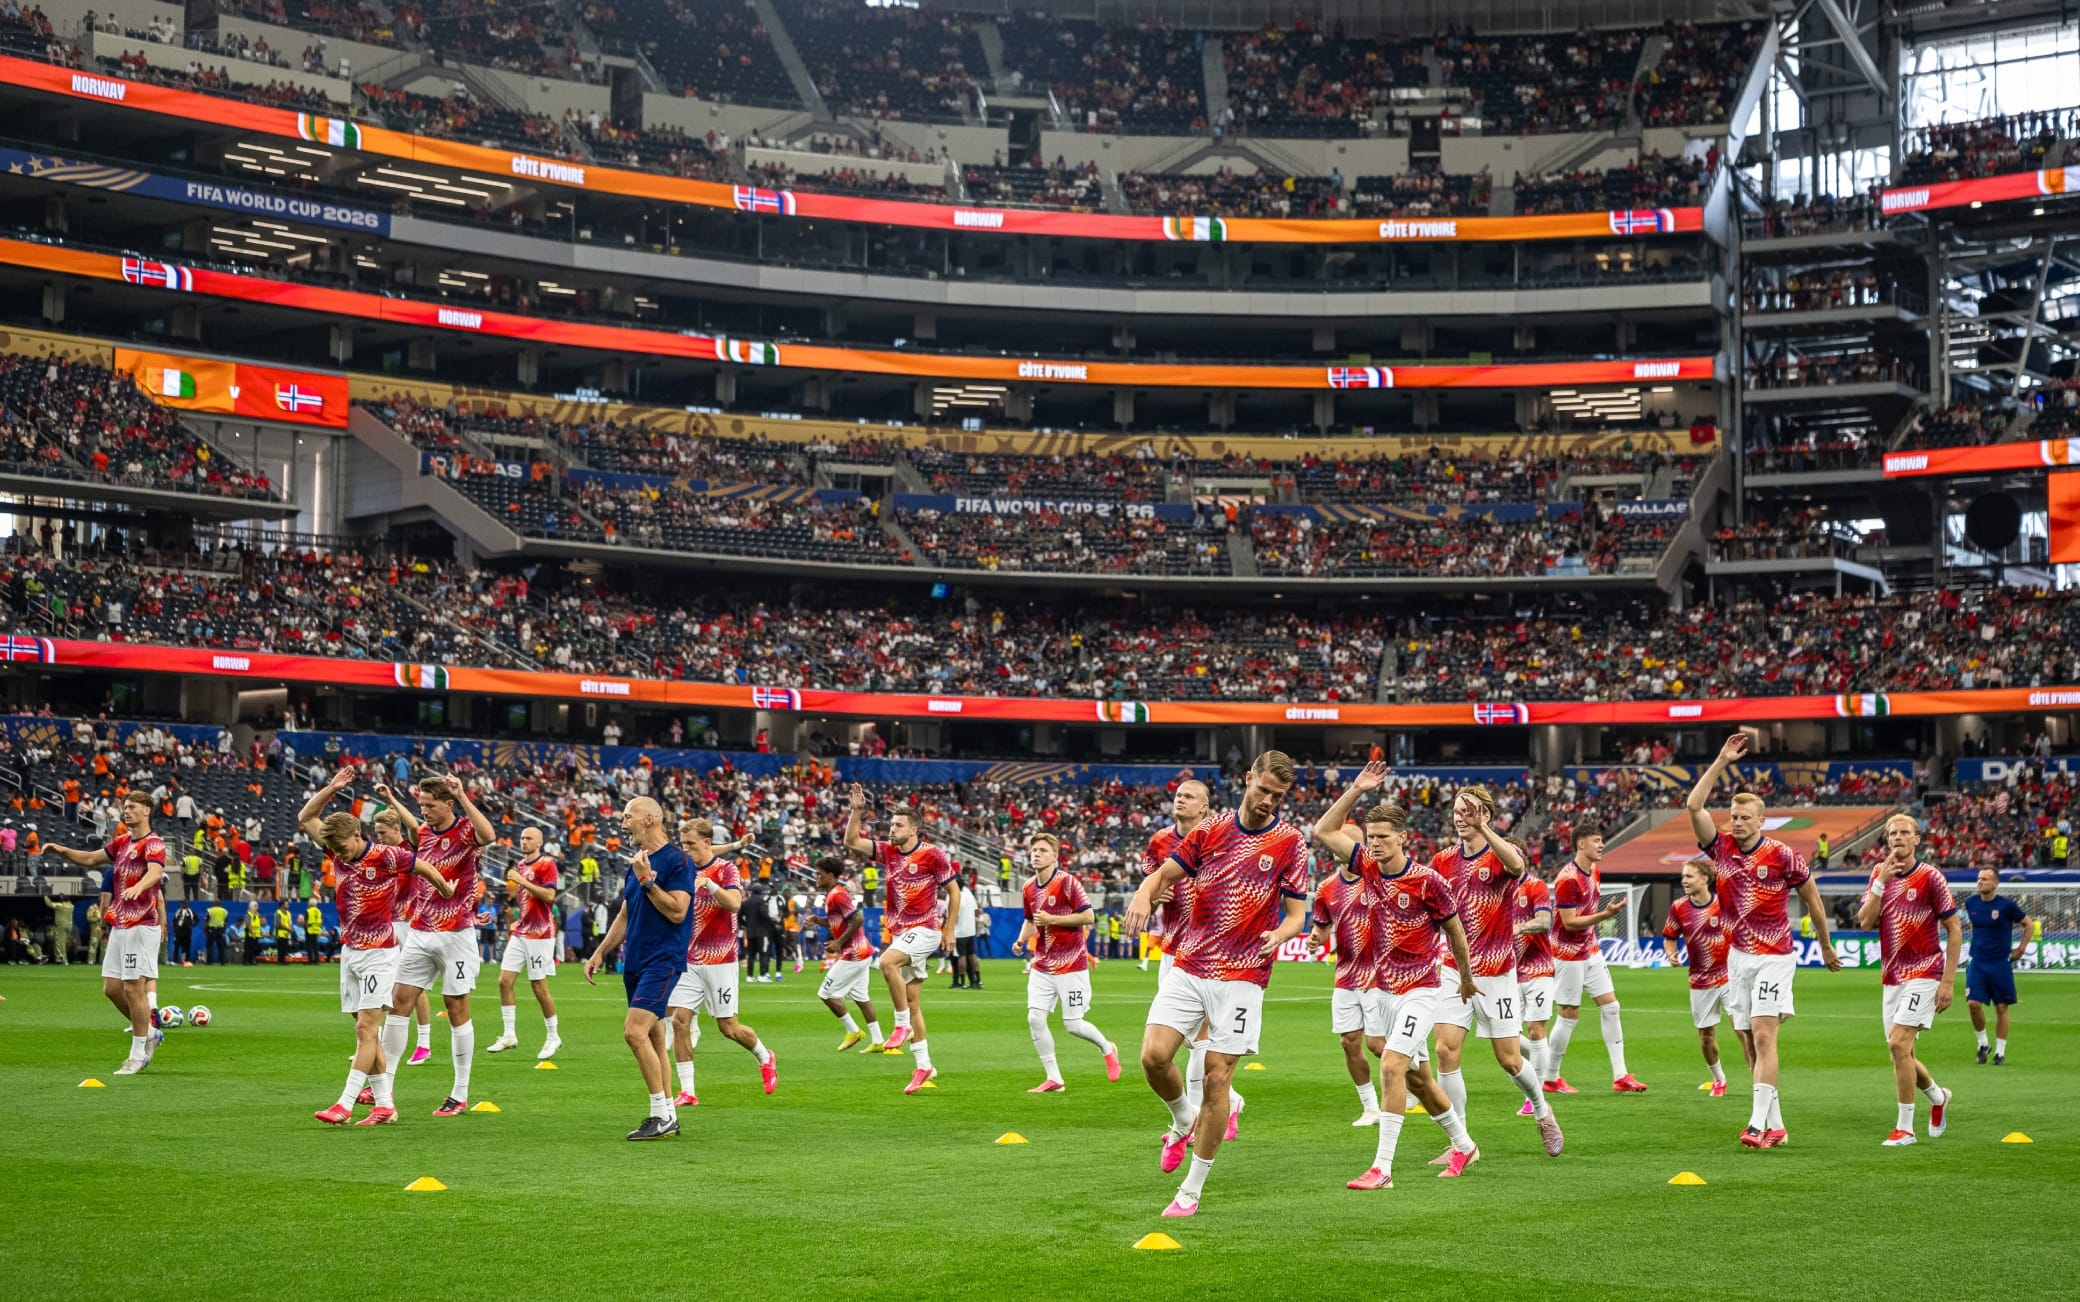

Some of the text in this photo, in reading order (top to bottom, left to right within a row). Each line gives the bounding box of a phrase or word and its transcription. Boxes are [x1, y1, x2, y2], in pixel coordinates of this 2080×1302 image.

[72, 74, 126, 100] NORWAY
[512, 155, 585, 185] CÔTE D'IVOIRE
[187, 182, 379, 228] FIFA WORLD CUP 2026
[1882, 189, 1930, 209] NORWAY
[954, 210, 1004, 228] NORWAY
[1380, 219, 1457, 238] CÔTE D'IVOIRE
[438, 309, 482, 329] NORWAY
[1018, 361, 1088, 380] CÔTE D'IVOIRE
[1634, 361, 1681, 378] NORWAY
[1886, 454, 1929, 473] NORWAY
[956, 498, 992, 513] FIFA
[1096, 503, 1155, 518] 226
[212, 655, 250, 671] NORWAY
[456, 961, 465, 979] 8
[530, 955, 542, 969] 14
[364, 974, 378, 994] 10
[1758, 981, 1779, 1001] 24
[717, 987, 731, 1005] 16
[1068, 990, 1083, 1007] 23
[1535, 991, 1545, 1008] 6
[1908, 993, 1920, 1012] 2
[1496, 997, 1513, 1020] 18
[1233, 1007, 1247, 1034] 3
[1402, 1014, 1418, 1038] 5
